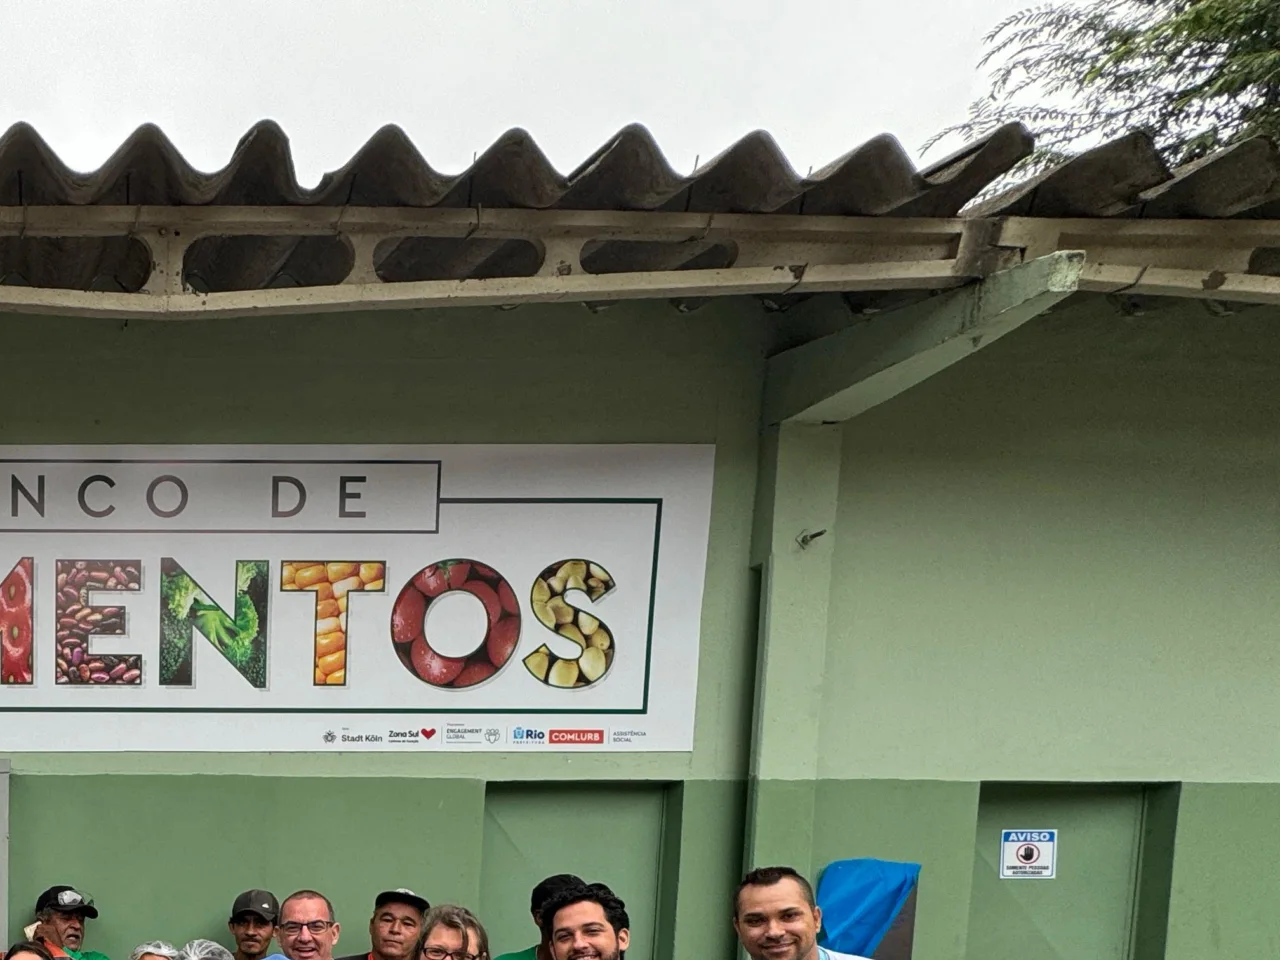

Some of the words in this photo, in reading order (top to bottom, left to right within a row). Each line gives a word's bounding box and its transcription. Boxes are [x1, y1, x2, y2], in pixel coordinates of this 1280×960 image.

[270, 475, 368, 518] DE
[341, 734, 363, 743] Stadt
[365, 733, 383, 743] Köln
[388, 730, 407, 738] Zona
[408, 730, 419, 738] Sul
[525, 729, 545, 739] Rio
[551, 732, 600, 741] COMLURB
[1008, 832, 1051, 841] AVISO
